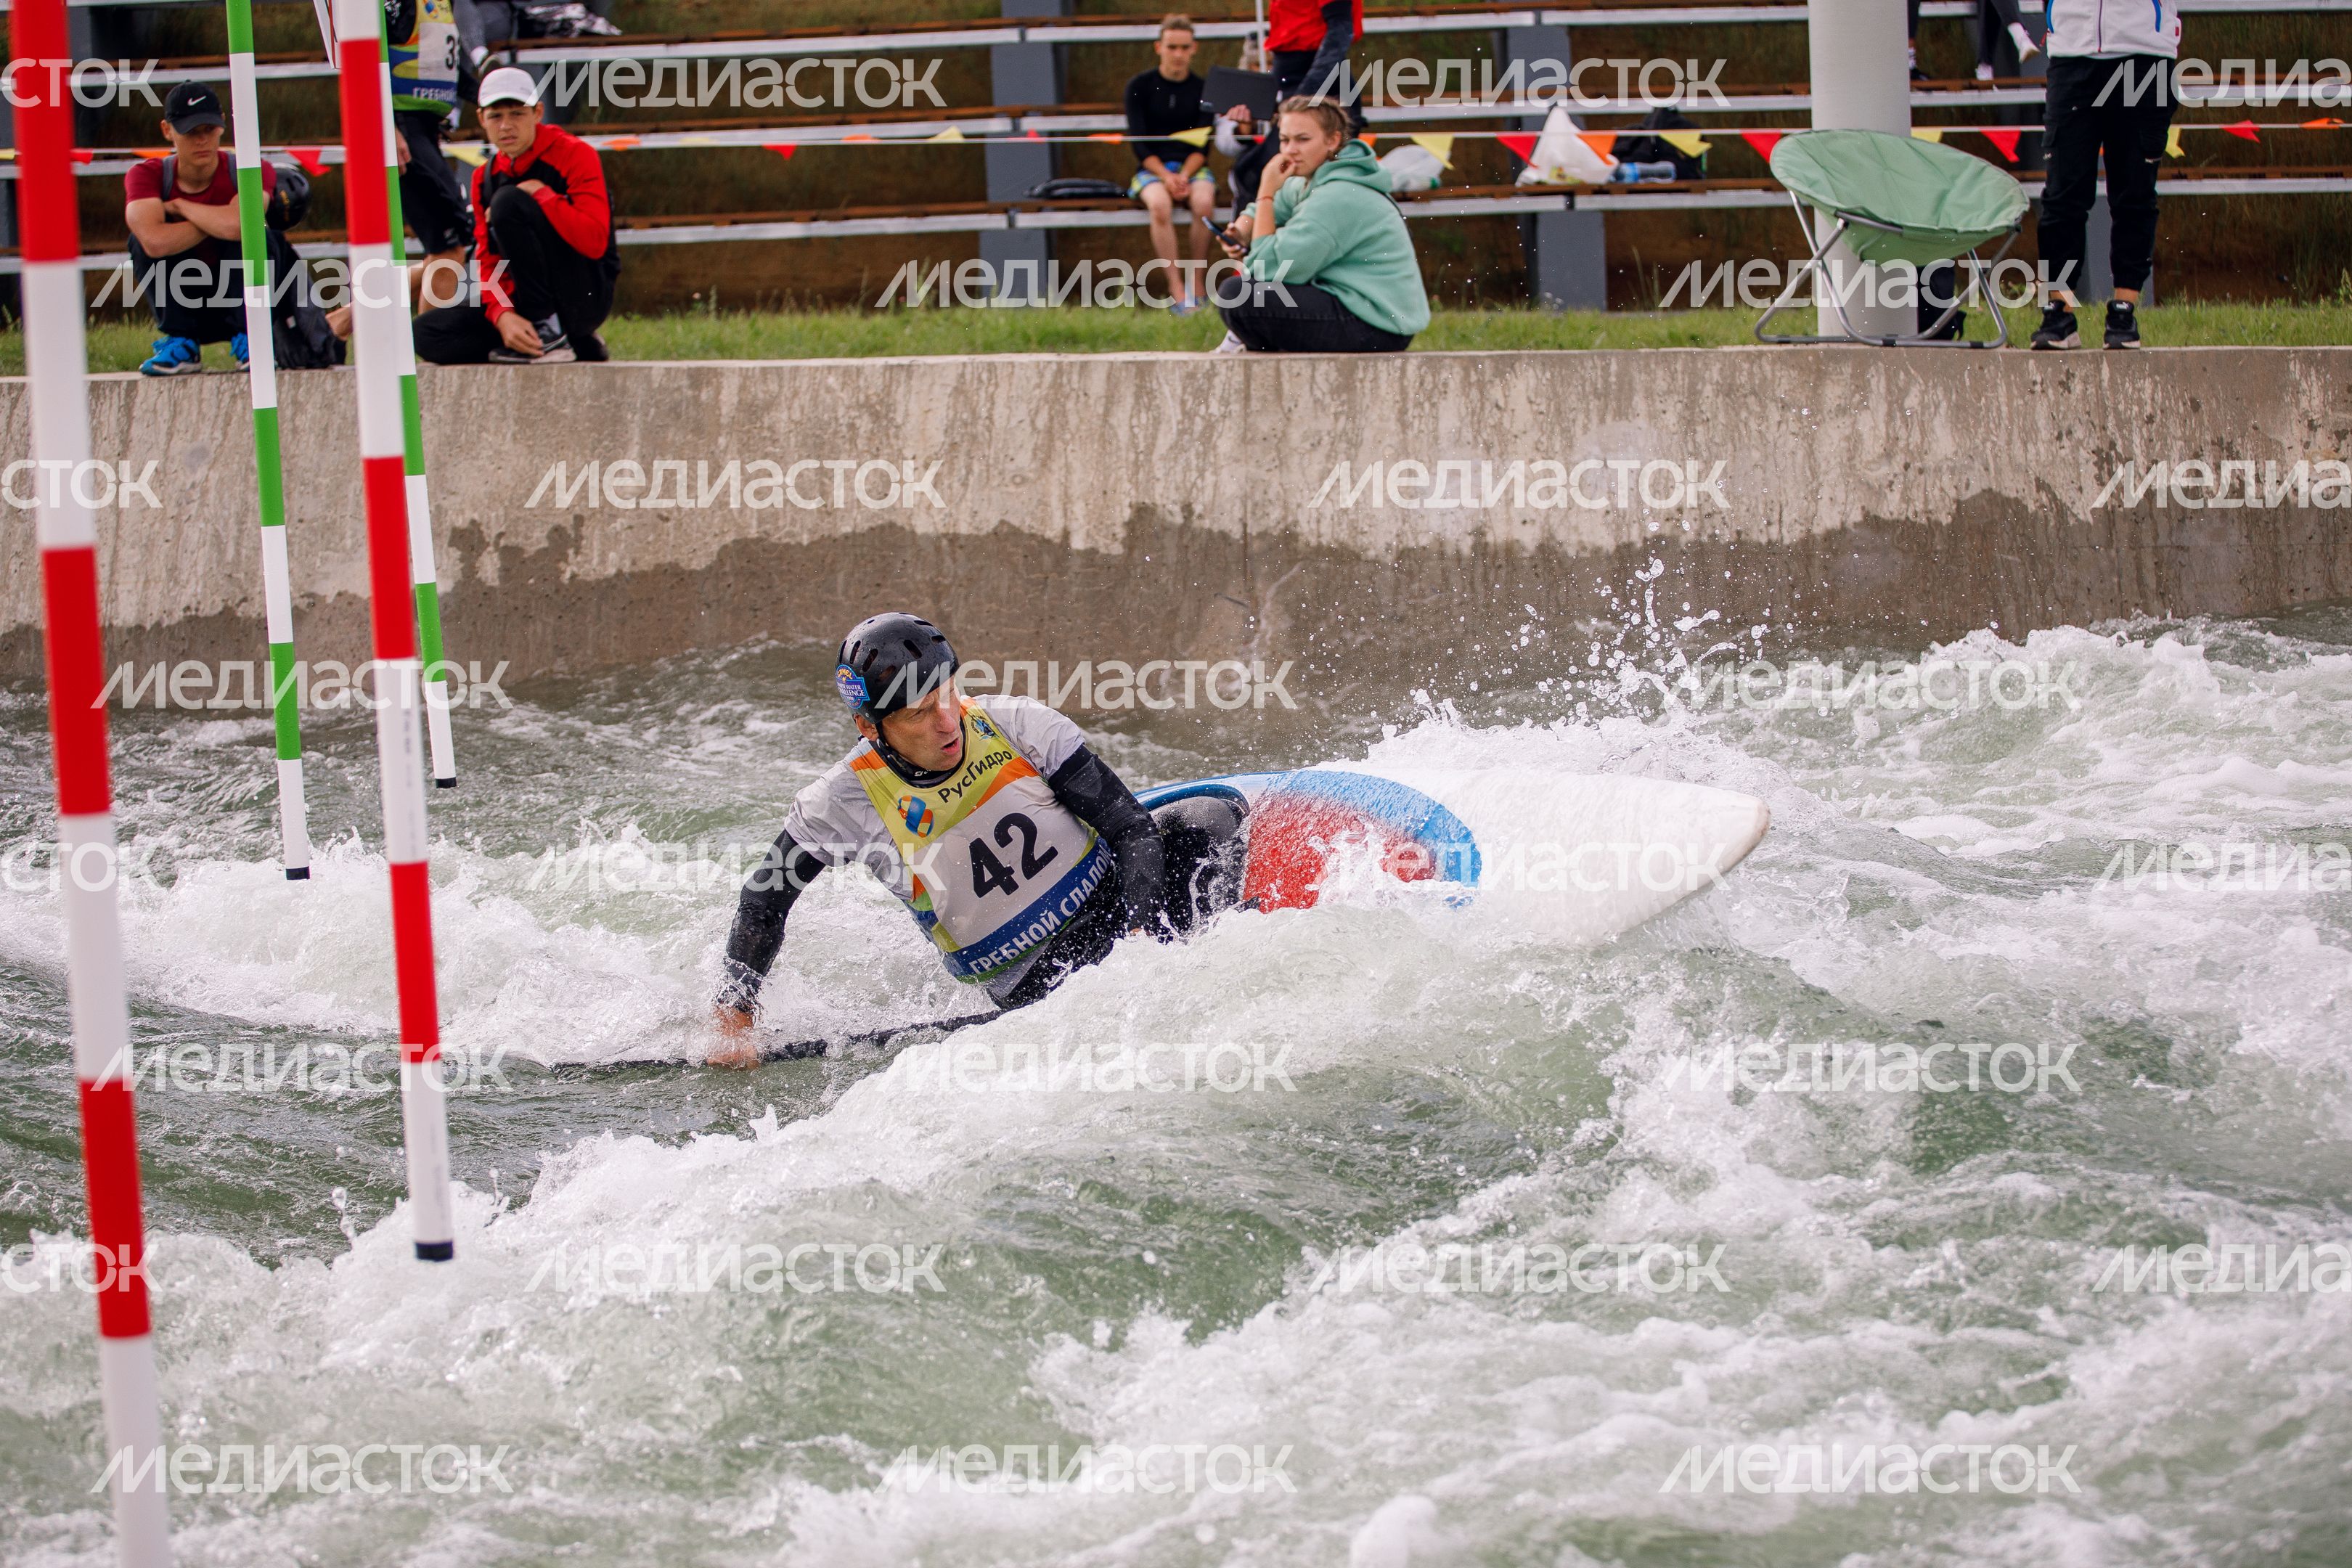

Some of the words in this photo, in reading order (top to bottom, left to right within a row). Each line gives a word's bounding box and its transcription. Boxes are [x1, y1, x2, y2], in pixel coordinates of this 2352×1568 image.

[937, 750, 1013, 803] РусГидро
[969, 812, 1058, 898] 42
[968, 909, 1061, 975] ГРЕБНОЙ
[1060, 844, 1112, 915] СЛАЛОМ
